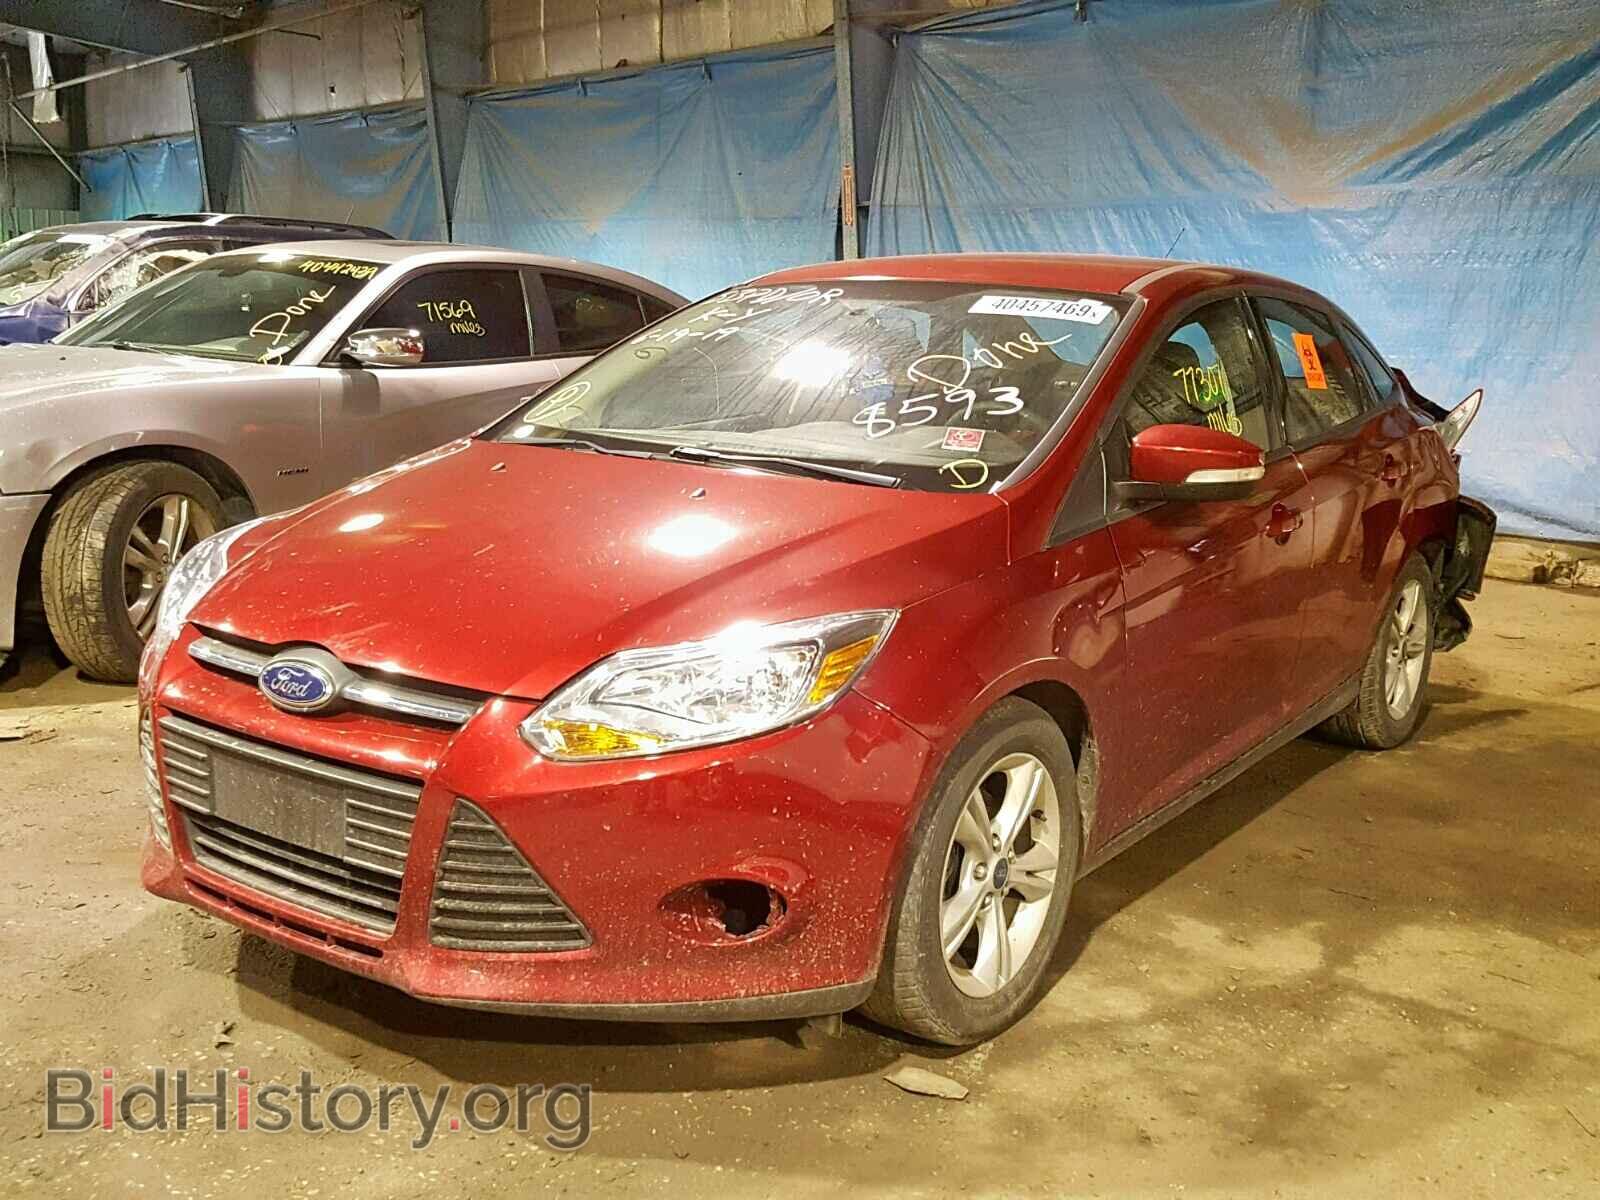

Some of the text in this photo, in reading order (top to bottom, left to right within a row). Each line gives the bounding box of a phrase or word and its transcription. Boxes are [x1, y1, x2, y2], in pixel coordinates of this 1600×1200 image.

[249, 285, 337, 345] Done
[417, 300, 476, 322] 71569
[991, 298, 1092, 317] 40457469
[907, 332, 1073, 394] Done
[852, 386, 1024, 440] 8593
[270, 667, 313, 697] Ford
